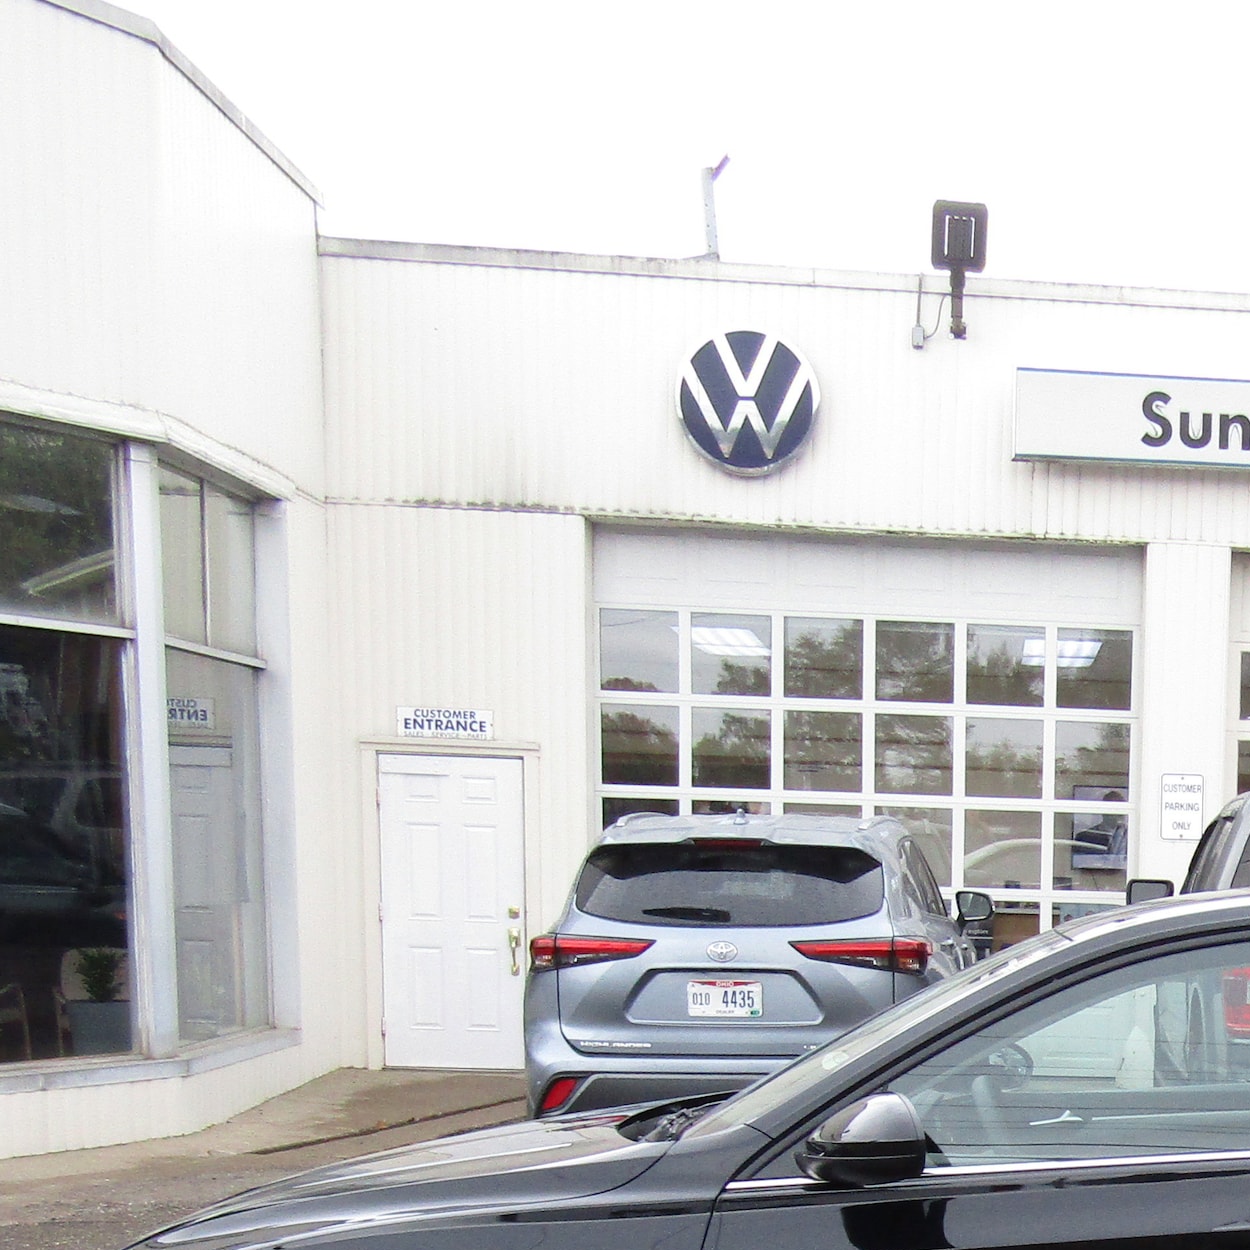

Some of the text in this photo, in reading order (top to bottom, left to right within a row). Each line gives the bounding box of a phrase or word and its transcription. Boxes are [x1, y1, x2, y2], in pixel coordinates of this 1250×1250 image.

[679, 330, 816, 468] VW
[414, 708, 476, 719] CUSTOMER
[404, 718, 487, 732] ENTRANCE
[1163, 784, 1202, 793] CUSTOMER
[1164, 802, 1200, 811] PARKING
[1172, 821, 1191, 830] ONLY
[692, 990, 755, 1008] 010 4435
